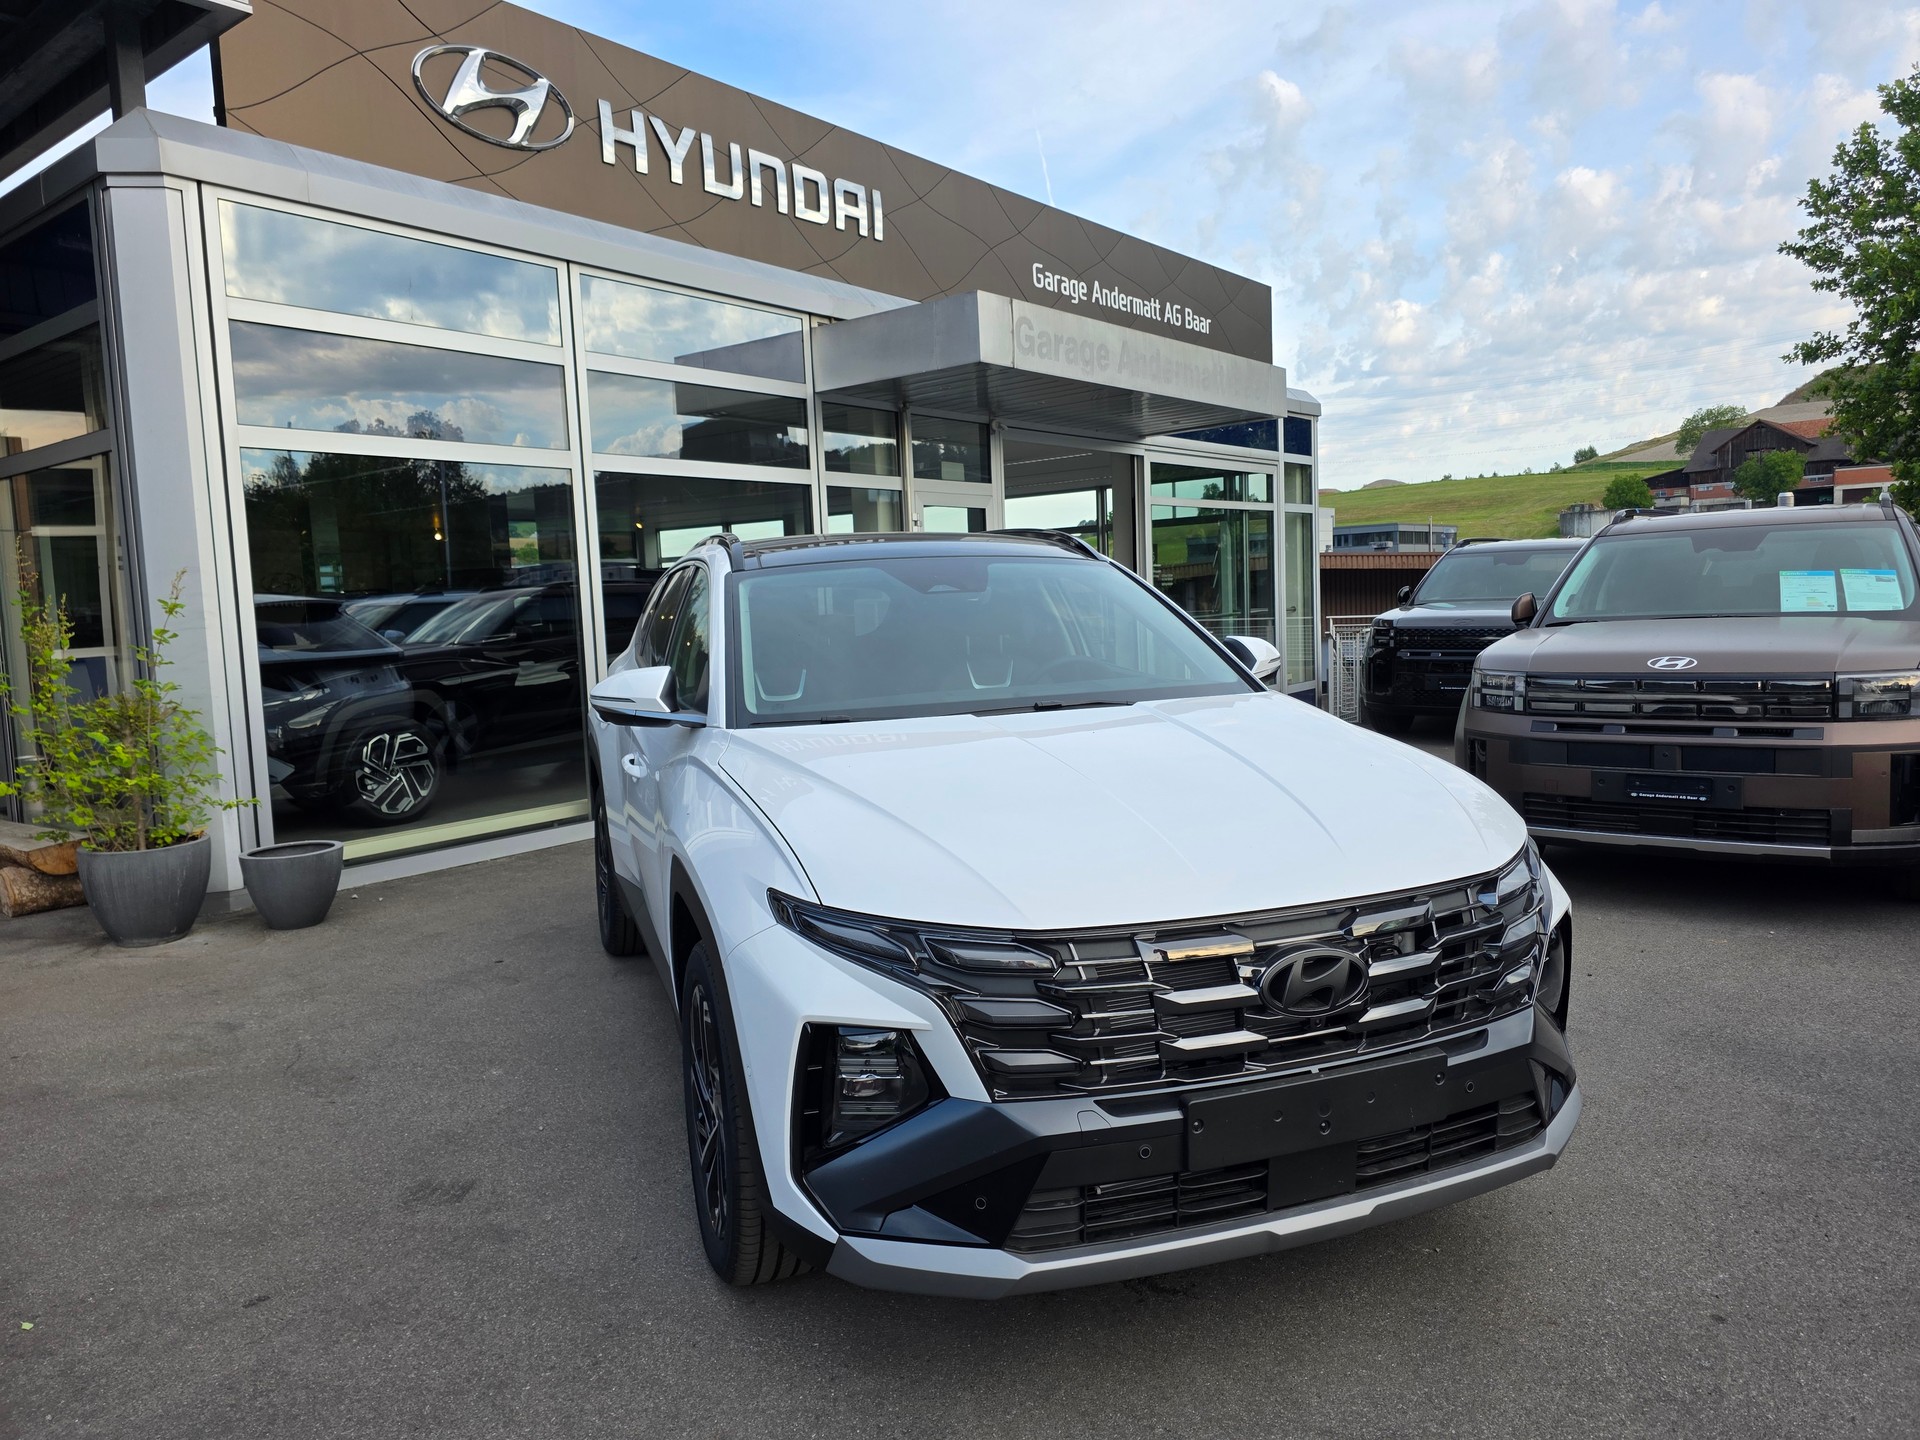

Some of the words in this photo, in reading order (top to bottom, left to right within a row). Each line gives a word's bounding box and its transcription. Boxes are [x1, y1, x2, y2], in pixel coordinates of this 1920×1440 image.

[597, 98, 884, 242] HYUNDAI
[1032, 262, 1088, 304] Garage
[1091, 280, 1162, 321] Andermatt
[1164, 301, 1182, 327] AG
[1184, 307, 1212, 335] Baar
[1015, 316, 1110, 377] Garage
